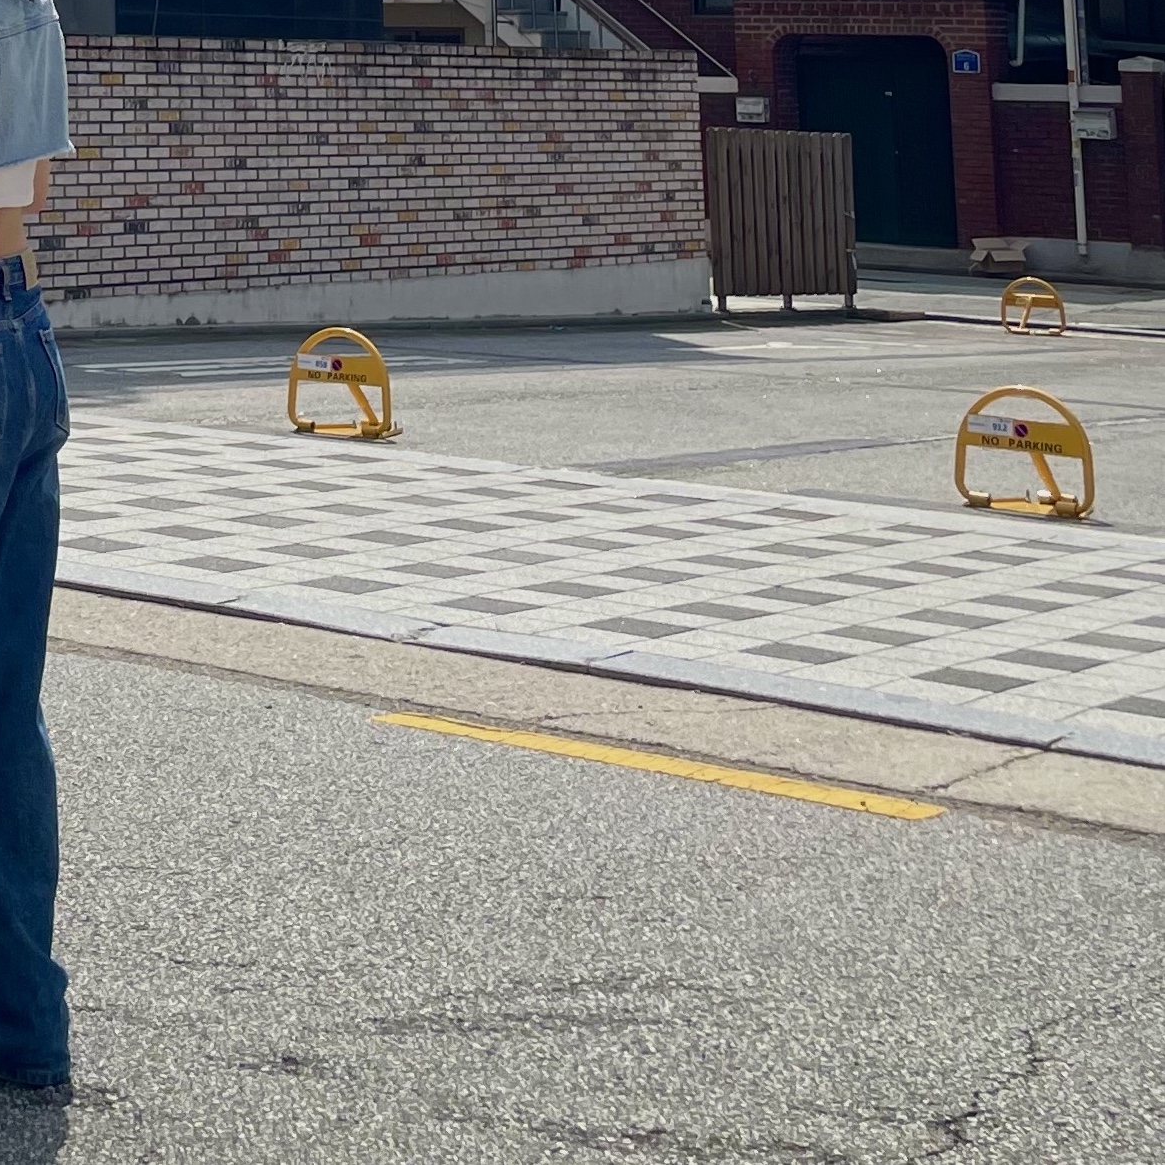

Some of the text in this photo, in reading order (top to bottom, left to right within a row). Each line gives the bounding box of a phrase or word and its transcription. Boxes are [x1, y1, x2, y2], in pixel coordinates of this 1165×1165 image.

[308, 371, 367, 383] NO PARKING
[992, 422, 1007, 432] 912
[981, 435, 1063, 453] NO PARKING
